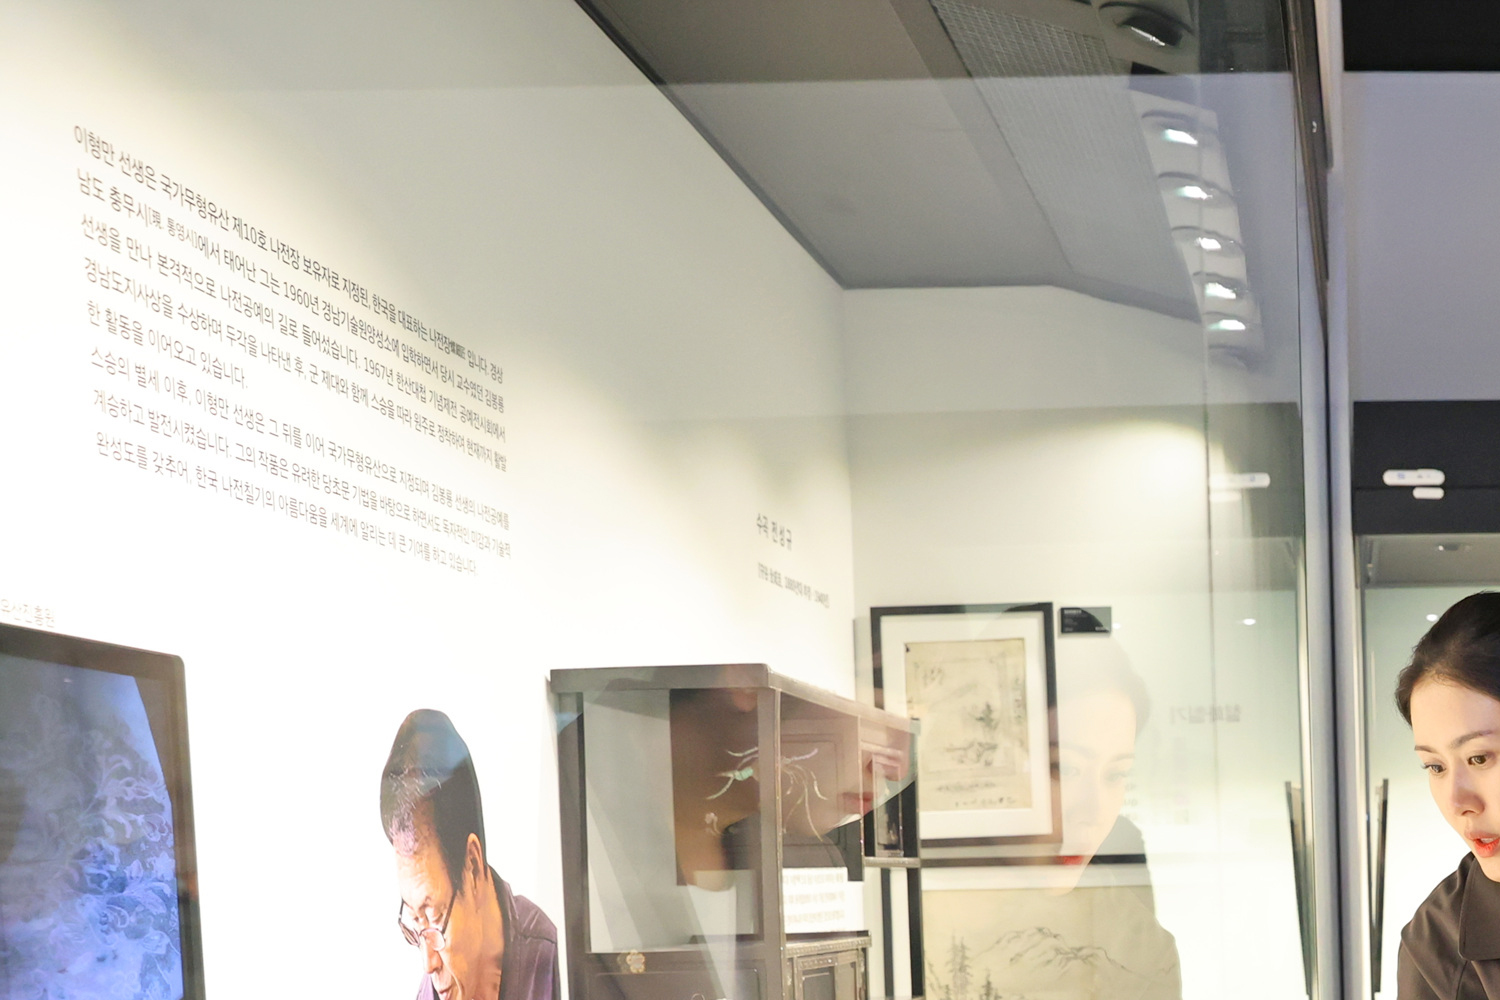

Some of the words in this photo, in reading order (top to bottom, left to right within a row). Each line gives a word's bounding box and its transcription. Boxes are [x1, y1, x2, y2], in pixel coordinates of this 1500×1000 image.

[74, 126, 114, 167] 이형만
[119, 152, 156, 190] 선생은
[161, 174, 229, 231] 국가무형유산
[232, 217, 267, 251] 제10호
[270, 238, 300, 270] 나전장
[303, 256, 340, 290] 보유자로
[343, 278, 370, 309] 지정된,
[373, 294, 396, 324] 한국을
[398, 310, 427, 341] 대표하는
[491, 363, 503, 384] 경상
[78, 169, 105, 201] 남도
[224, 250, 256, 283] 태어난
[260, 269, 280, 295] 그는
[284, 282, 319, 315] 1960년
[322, 301, 399, 357] 경남기술원양성소에
[402, 344, 438, 378] 입학하면서
[440, 365, 454, 387] 당시
[81, 215, 120, 253] 선생을
[127, 237, 152, 267] 만나
[157, 252, 216, 298] 본격적으로
[221, 286, 274, 328] 나전공예의
[279, 313, 298, 338] 길로
[302, 324, 360, 369] 들어섰습니다.
[364, 357, 393, 386] 1967년
[397, 372, 426, 403] 한산대첩
[429, 390, 457, 418] 기념제전
[88, 301, 100, 326] 한
[105, 308, 143, 346] 활동을
[149, 329, 196, 366] 이어오고
[200, 352, 248, 389] 있습니다.
[85, 257, 173, 319] 경남도지사상을
[178, 304, 222, 341] 수상하며
[226, 325, 257, 357] 두각을
[261, 343, 291, 372] 나타낸
[295, 357, 306, 379] 후,
[309, 364, 318, 384] 군
[322, 370, 349, 398] 제대와
[351, 383, 368, 407] 함께
[372, 394, 394, 419] 스승을
[397, 406, 412, 427] 따라
[414, 413, 435, 437] 원주로
[91, 347, 130, 381] 스승의
[135, 364, 159, 392] 별세
[164, 376, 192, 405] 이후,
[196, 389, 229, 420] 이형만
[233, 404, 265, 434] 선생은
[269, 419, 279, 437] 그
[283, 423, 301, 448] 뒤를
[306, 433, 324, 457] 이어
[328, 441, 397, 483] 국가무형유산으로
[400, 471, 429, 497] 지정되며
[455, 495, 476, 517] 선생의
[477, 503, 510, 531] 나전공예를
[94, 390, 144, 425] 계승하고
[148, 409, 232, 458] 발전시켰습니다.
[235, 443, 255, 467] 그의
[259, 451, 288, 479] 작품은
[292, 463, 320, 490] 유려한
[323, 475, 350, 500] 당초문
[353, 486, 377, 511] 기법을
[380, 497, 410, 521] 바탕으로
[413, 508, 441, 532] 하면서도
[471, 530, 491, 552] 미감과
[97, 432, 147, 469] 완성도를
[153, 452, 192, 484] 갖추어,
[196, 466, 217, 492] 한국
[222, 476, 276, 511] 나전칠기의
[279, 495, 327, 528] 아름다움을
[331, 514, 357, 536] 세계에
[361, 522, 386, 546] 알리는
[399, 535, 406, 553] 큰
[409, 539, 430, 561] 기여를
[433, 547, 447, 565] 하고
[448, 553, 479, 577] 있습니다.
